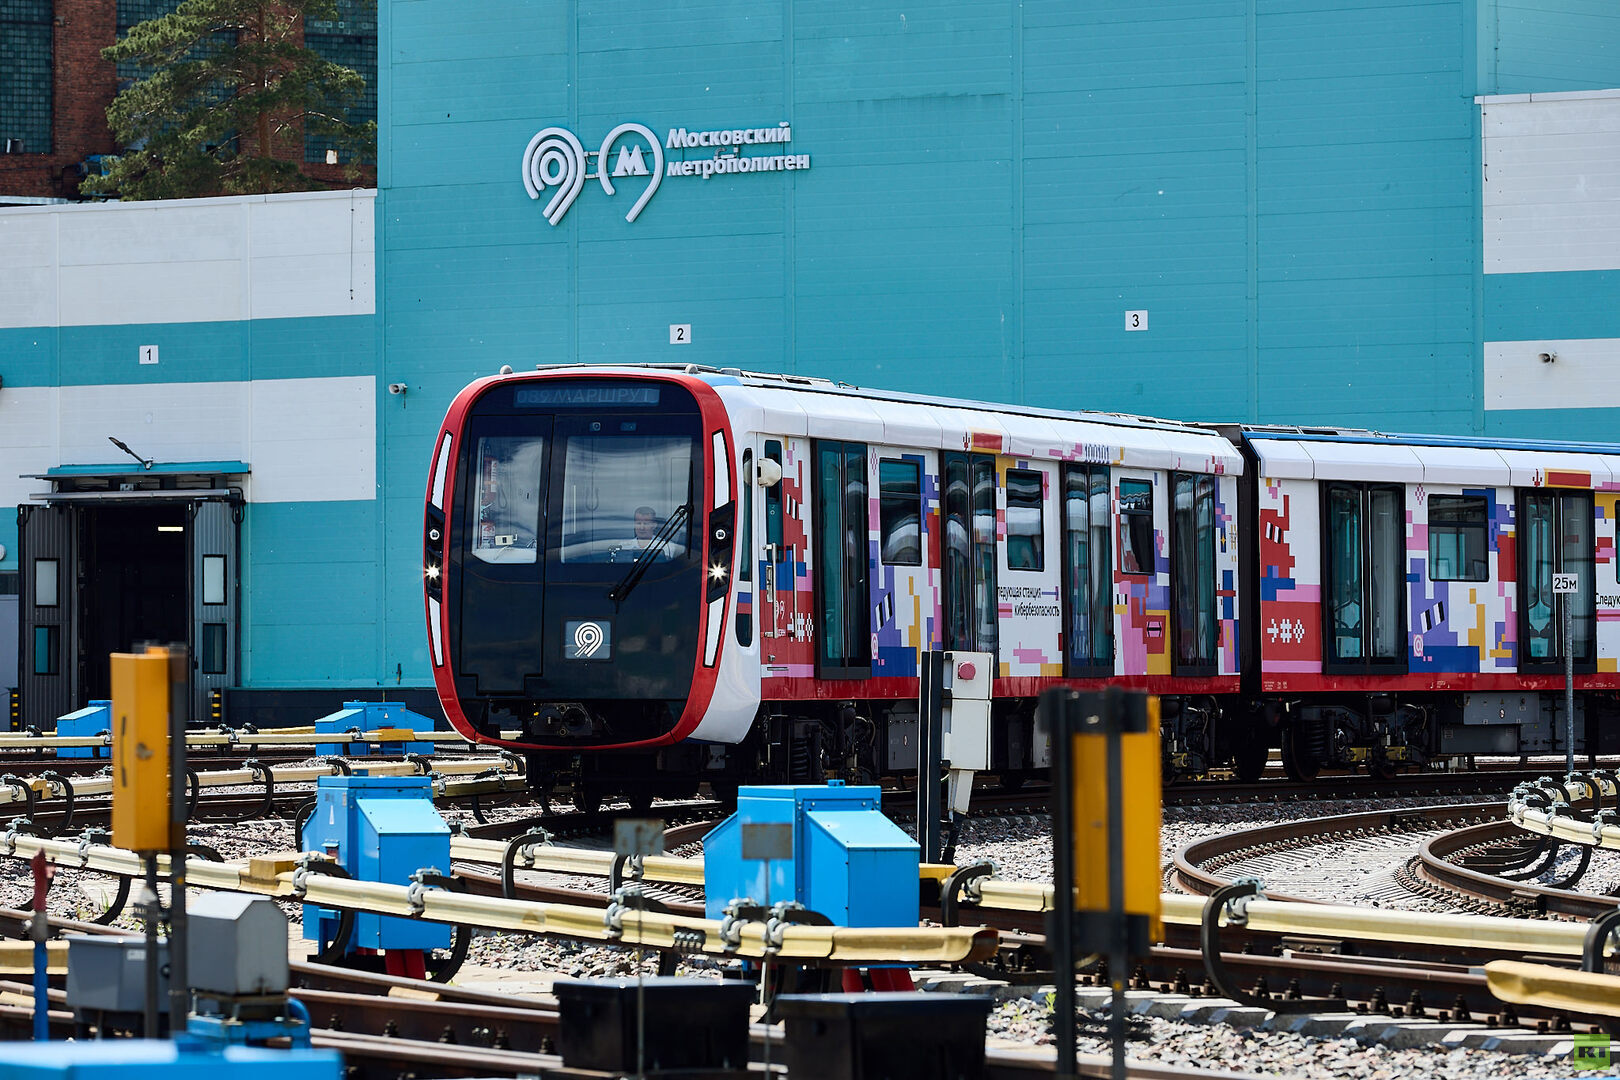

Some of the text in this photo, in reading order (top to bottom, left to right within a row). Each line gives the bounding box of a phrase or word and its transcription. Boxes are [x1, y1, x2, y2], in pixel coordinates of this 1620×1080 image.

[666, 121, 791, 148] Московский
[666, 154, 810, 179] метрополитен
[1132, 313, 1140, 328] 3
[676, 327, 684, 341] 2
[146, 348, 151, 361] 1
